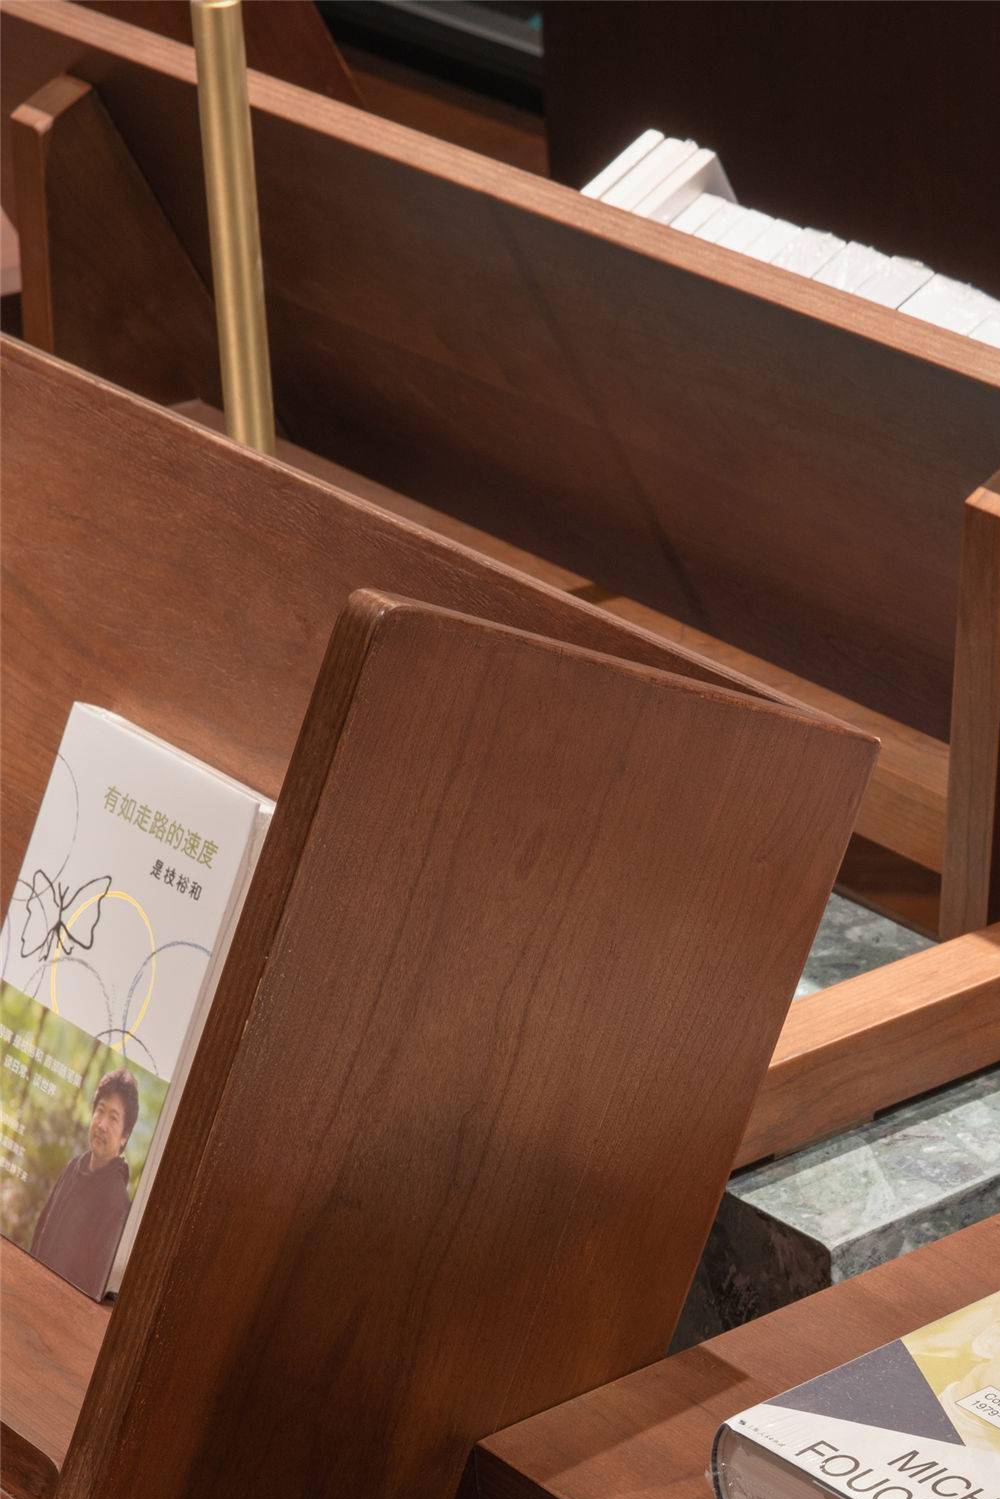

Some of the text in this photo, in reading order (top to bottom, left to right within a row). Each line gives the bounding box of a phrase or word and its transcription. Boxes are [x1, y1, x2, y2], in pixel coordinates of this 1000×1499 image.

[105, 787, 218, 868] 有如走路的速度
[150, 860, 202, 900] 是枝裕和
